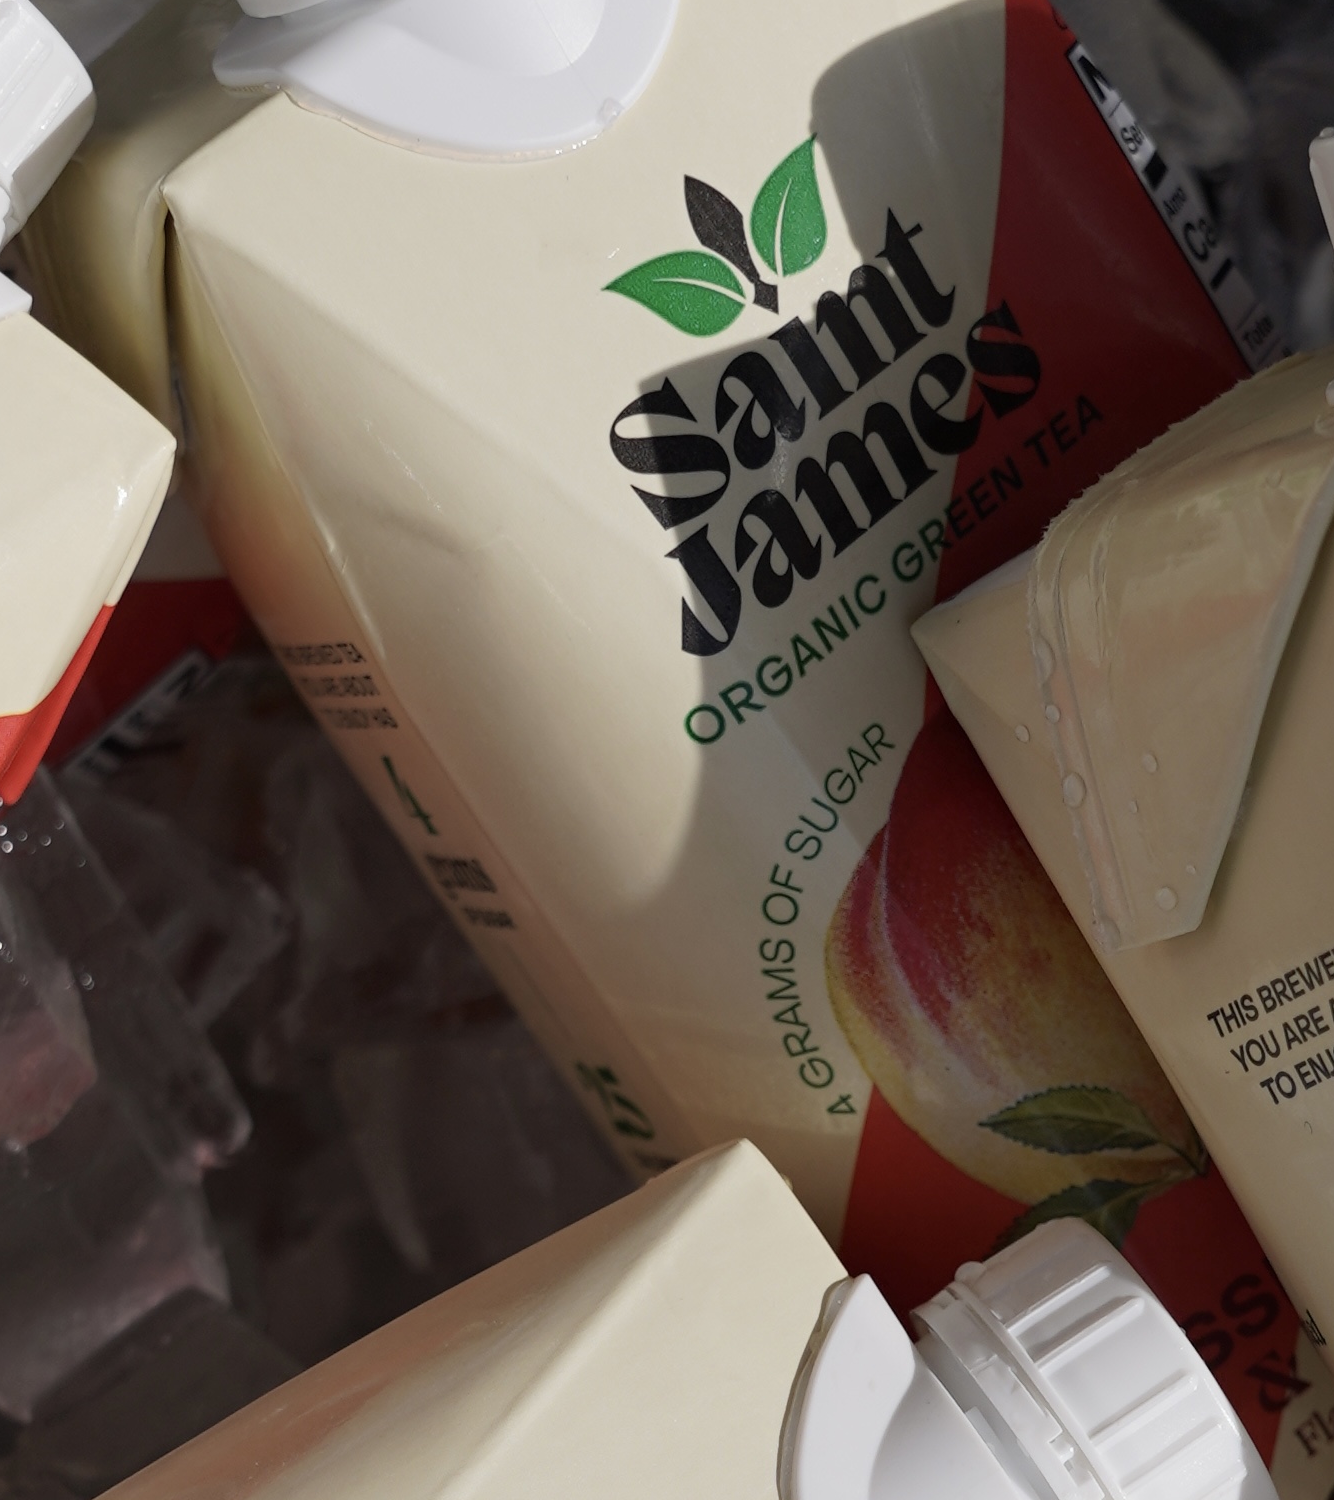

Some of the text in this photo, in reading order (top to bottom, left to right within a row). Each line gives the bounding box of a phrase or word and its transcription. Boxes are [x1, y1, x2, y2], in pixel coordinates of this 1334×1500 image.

[610, 208, 955, 531] Saint
[664, 302, 1041, 657] James
[684, 394, 1103, 745] ORGANIC GREEN TEA
[785, 722, 896, 860] SUGAR
[762, 864, 803, 926] OF
[759, 938, 835, 1089] GRAMS
[1207, 994, 1260, 1039] THIS
[1230, 1029, 1281, 1073] YOU
[1283, 1005, 1330, 1052] ARE
[1260, 1070, 1296, 1106] TO
